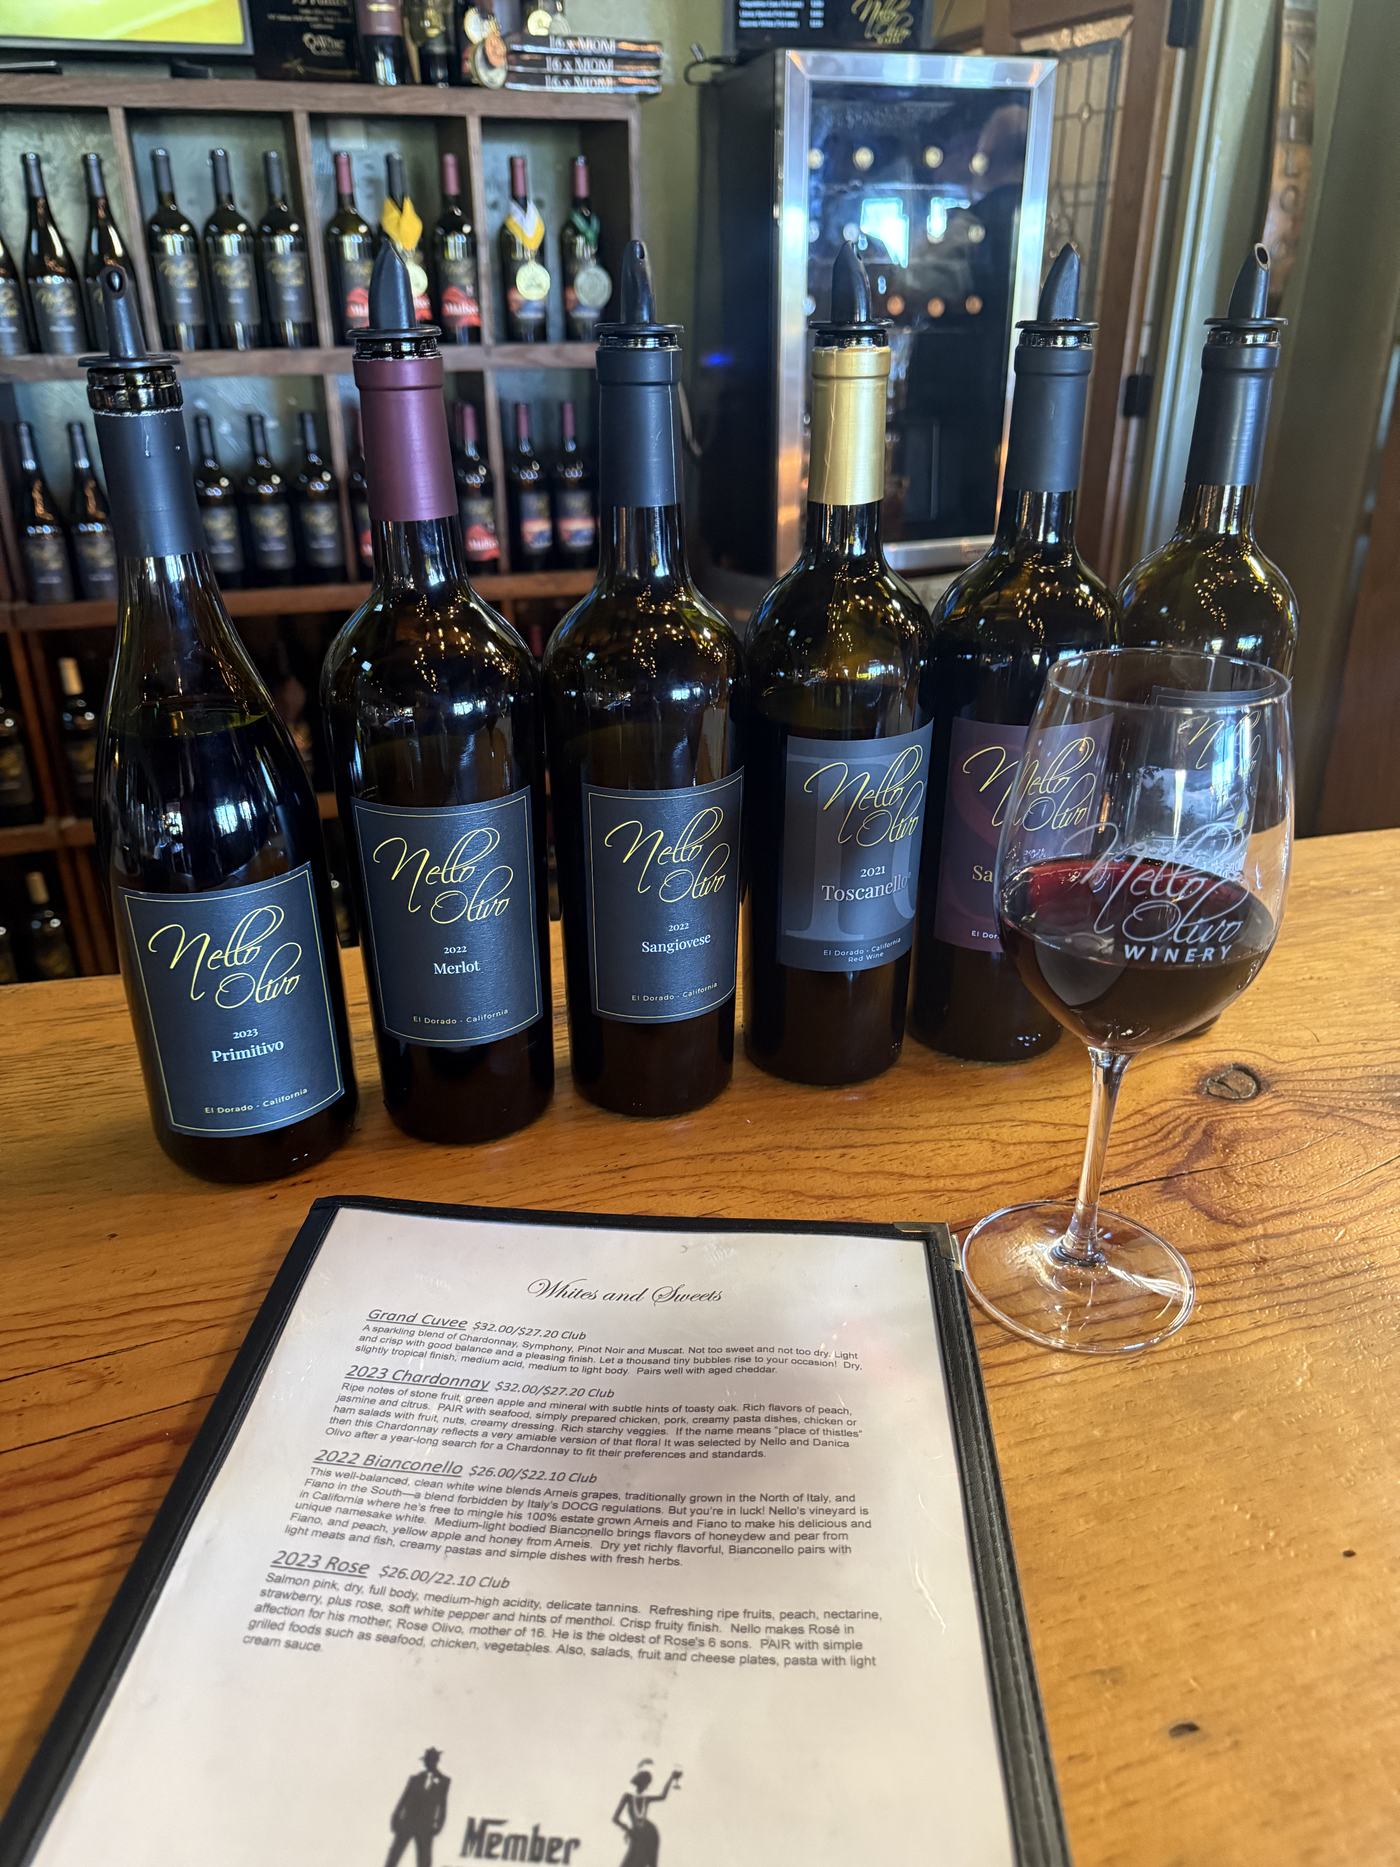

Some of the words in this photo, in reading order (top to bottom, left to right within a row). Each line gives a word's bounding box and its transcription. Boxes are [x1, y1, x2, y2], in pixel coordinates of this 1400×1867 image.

[578, 36, 615, 54] MOM
[546, 55, 562, 72] 16
[575, 57, 614, 73] MOM
[574, 76, 613, 89] MOM
[803, 744, 923, 844] Nello
[962, 736, 1095, 827] Nello
[856, 780, 924, 847] Olivo
[1023, 772, 1095, 831] Olivo
[604, 806, 724, 894] Nello
[373, 827, 500, 913] Nello
[658, 842, 731, 903] Olivo
[860, 866, 885, 878] 2021
[1061, 822, 1245, 934] Nello
[430, 865, 514, 925] Olivo
[1122, 876, 1250, 944] Olivo
[668, 922, 689, 932] 2022
[148, 905, 285, 1001] Nello
[443, 945, 468, 955] 2022
[641, 933, 711, 955] Sangiovese
[848, 955, 863, 963] Red
[866, 952, 884, 960] Wine
[871, 937, 901, 952] California
[1124, 945, 1232, 963] WINERY
[215, 942, 302, 1009] Olivo
[433, 960, 481, 975] Merlot
[643, 994, 674, 1002] Dorado
[682, 981, 718, 998] California
[413, 1015, 422, 1023] El
[424, 1017, 457, 1025] Dorado
[466, 1007, 509, 1023] California
[232, 1027, 259, 1040] 2023
[211, 1038, 285, 1063] Primitivo
[204, 1106, 214, 1114] El
[217, 1103, 254, 1114] Dorado
[263, 1087, 308, 1108] California
[527, 1278, 599, 1300] Whites
[602, 1287, 650, 1301] and
[652, 1283, 723, 1307] Sweets
[368, 1309, 417, 1323] Grand
[421, 1314, 468, 1328] Cuvee
[472, 1321, 559, 1339] $32.00/$27.20
[561, 1330, 586, 1340] Club
[354, 1344, 389, 1356] slightly
[391, 1347, 428, 1358] tropical
[460, 1355, 500, 1365] medium
[527, 1362, 567, 1372] medium
[569, 1365, 579, 1373] to
[581, 1365, 602, 1375] light
[636, 1366, 661, 1375] Pairs
[663, 1366, 683, 1374] well
[685, 1366, 705, 1374] with
[707, 1365, 732, 1375] aged
[345, 1364, 387, 1379] 2023
[391, 1369, 490, 1391] Chardonnay
[495, 1381, 586, 1397] $32.00/$27.20
[588, 1388, 615, 1398] Club
[340, 1381, 364, 1393] Ripe
[366, 1386, 395, 1395] notes
[396, 1387, 409, 1396] of
[409, 1389, 438, 1399] stone
[464, 1395, 494, 1405] green
[496, 1398, 525, 1408] apple
[527, 1400, 547, 1408] and
[549, 1401, 587, 1410] mineral
[588, 1403, 609, 1411] with
[611, 1404, 642, 1412] subtle
[645, 1404, 669, 1413] hints
[671, 1404, 682, 1412] of
[684, 1404, 715, 1414] toasty
[742, 1403, 765, 1411] Rich
[767, 1402, 802, 1412] flavors
[804, 1404, 815, 1413] of
[314, 1449, 358, 1465] 2022
[363, 1454, 463, 1475] Bianconello
[468, 1465, 565, 1482] $26.00/$22.10
[568, 1472, 597, 1483] Club
[310, 1466, 332, 1477] This
[414, 1478, 443, 1488] clean
[446, 1481, 475, 1491] white
[477, 1483, 502, 1493] wine
[505, 1485, 541, 1496] blends
[543, 1487, 578, 1498] Arneis
[624, 1491, 686, 1504] traditionally
[688, 1495, 722, 1504] grown
[726, 1493, 735, 1502] in
[738, 1493, 756, 1502] the
[759, 1492, 789, 1502] North
[792, 1492, 804, 1502] of
[834, 1493, 855, 1502] and
[284, 1524, 309, 1536] light
[310, 1529, 345, 1540] meats
[348, 1534, 371, 1543] and
[399, 1539, 442, 1553] creamy
[444, 1545, 482, 1556] pastas
[484, 1548, 507, 1557] and
[508, 1548, 546, 1560] simple
[549, 1551, 586, 1561] dishes
[590, 1553, 612, 1563] with
[616, 1553, 644, 1564] fresh
[271, 1550, 321, 1569] 2023
[325, 1556, 370, 1575] Rose
[379, 1565, 476, 1587] $26.00/22.10
[478, 1576, 510, 1589] Club
[242, 1635, 281, 1646] cream
[247, 1618, 286, 1631] grilled
[288, 1620, 322, 1635] foods
[324, 1627, 354, 1638] such
[356, 1631, 372, 1641] as
[637, 1647, 661, 1660] fruit
[663, 1648, 688, 1661] and
[690, 1651, 735, 1664] cheese
[783, 1655, 818, 1668] pasta
[820, 1655, 846, 1666] with
[850, 1655, 876, 1669] light
[460, 1815, 581, 1865] Member
